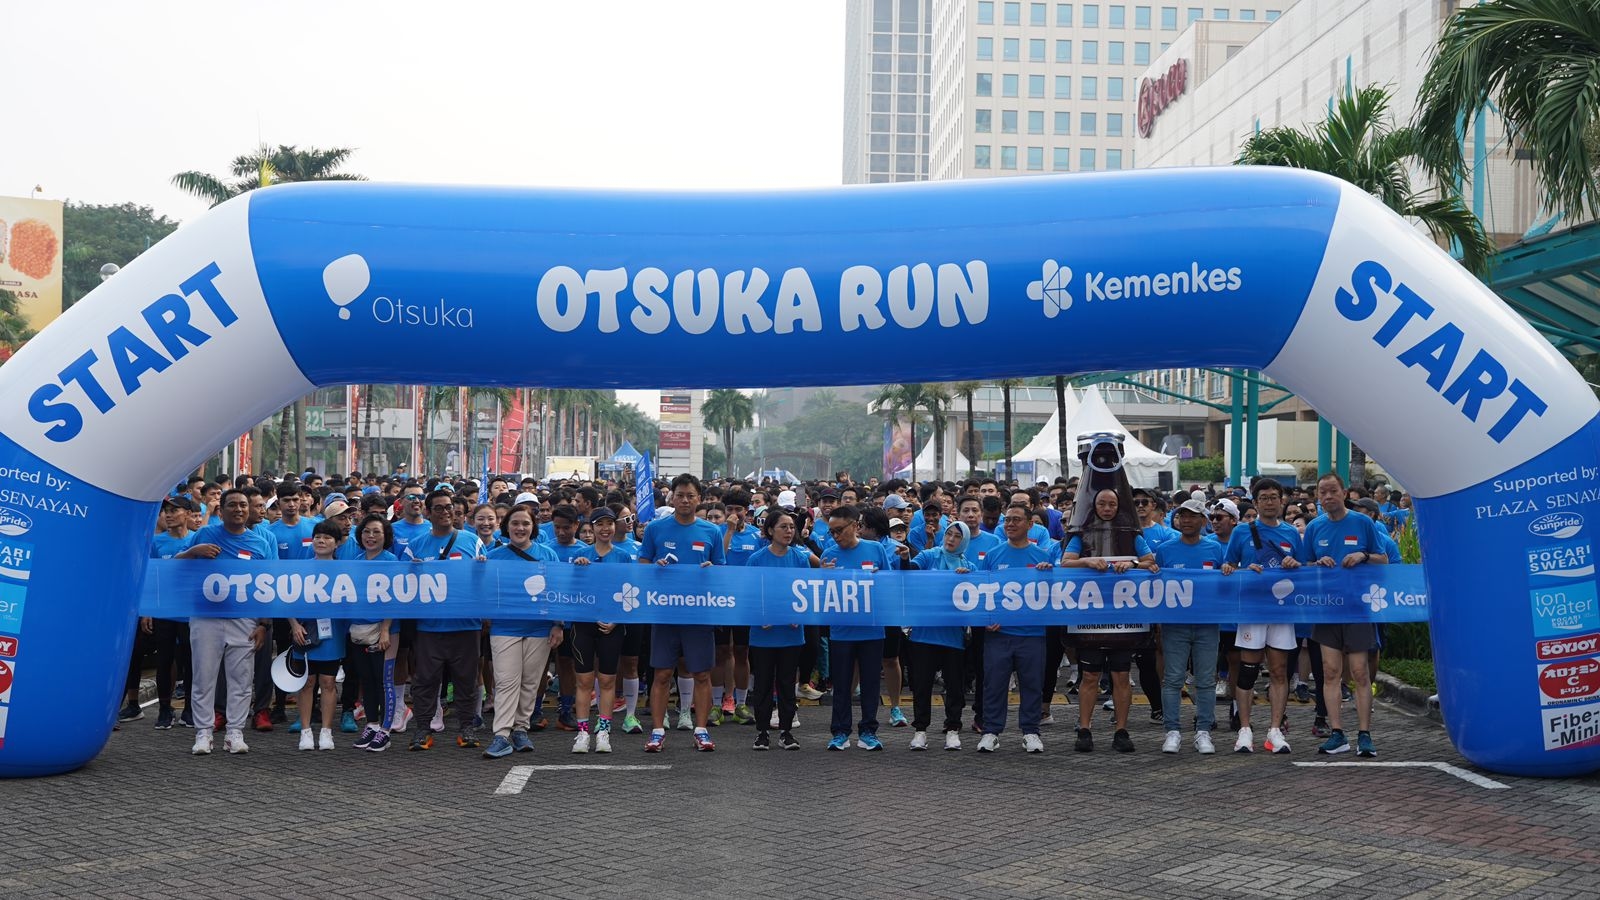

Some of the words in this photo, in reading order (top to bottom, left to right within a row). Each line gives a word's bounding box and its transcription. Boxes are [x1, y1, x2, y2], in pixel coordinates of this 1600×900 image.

[1085, 261, 1242, 302] Kemenkes
[536, 265, 823, 335] OTSUKA
[839, 260, 990, 332] RUN
[372, 296, 474, 328] Otsuka
[27, 261, 239, 443] START
[1334, 260, 1549, 444] START
[45, 472, 71, 492] by:
[1493, 467, 1577, 493] Supported
[1581, 465, 1599, 481] by:
[0, 489, 88, 518] SENAYAN
[1475, 500, 1539, 520] PLAZA
[1533, 518, 1580, 532] Sunpride
[1528, 545, 1591, 563] POCARI
[1530, 555, 1586, 572] SWEAT
[202, 573, 358, 604] OTSUKA
[366, 573, 448, 604] RUN
[545, 590, 596, 605] Otsuka
[791, 579, 874, 613] START
[952, 580, 1104, 611] OTSUKA
[1112, 579, 1194, 609] RUN
[646, 590, 736, 608] Kemenkes
[1294, 593, 1345, 607] Otsuka
[1535, 592, 1567, 607] ion
[1536, 598, 1593, 618] water
[1541, 638, 1598, 656] SOYJOY
[1544, 663, 1599, 679] オロナミン
[1567, 675, 1580, 686] C
[1550, 710, 1600, 733] Fibe-
[1552, 720, 1599, 746] -Mini
